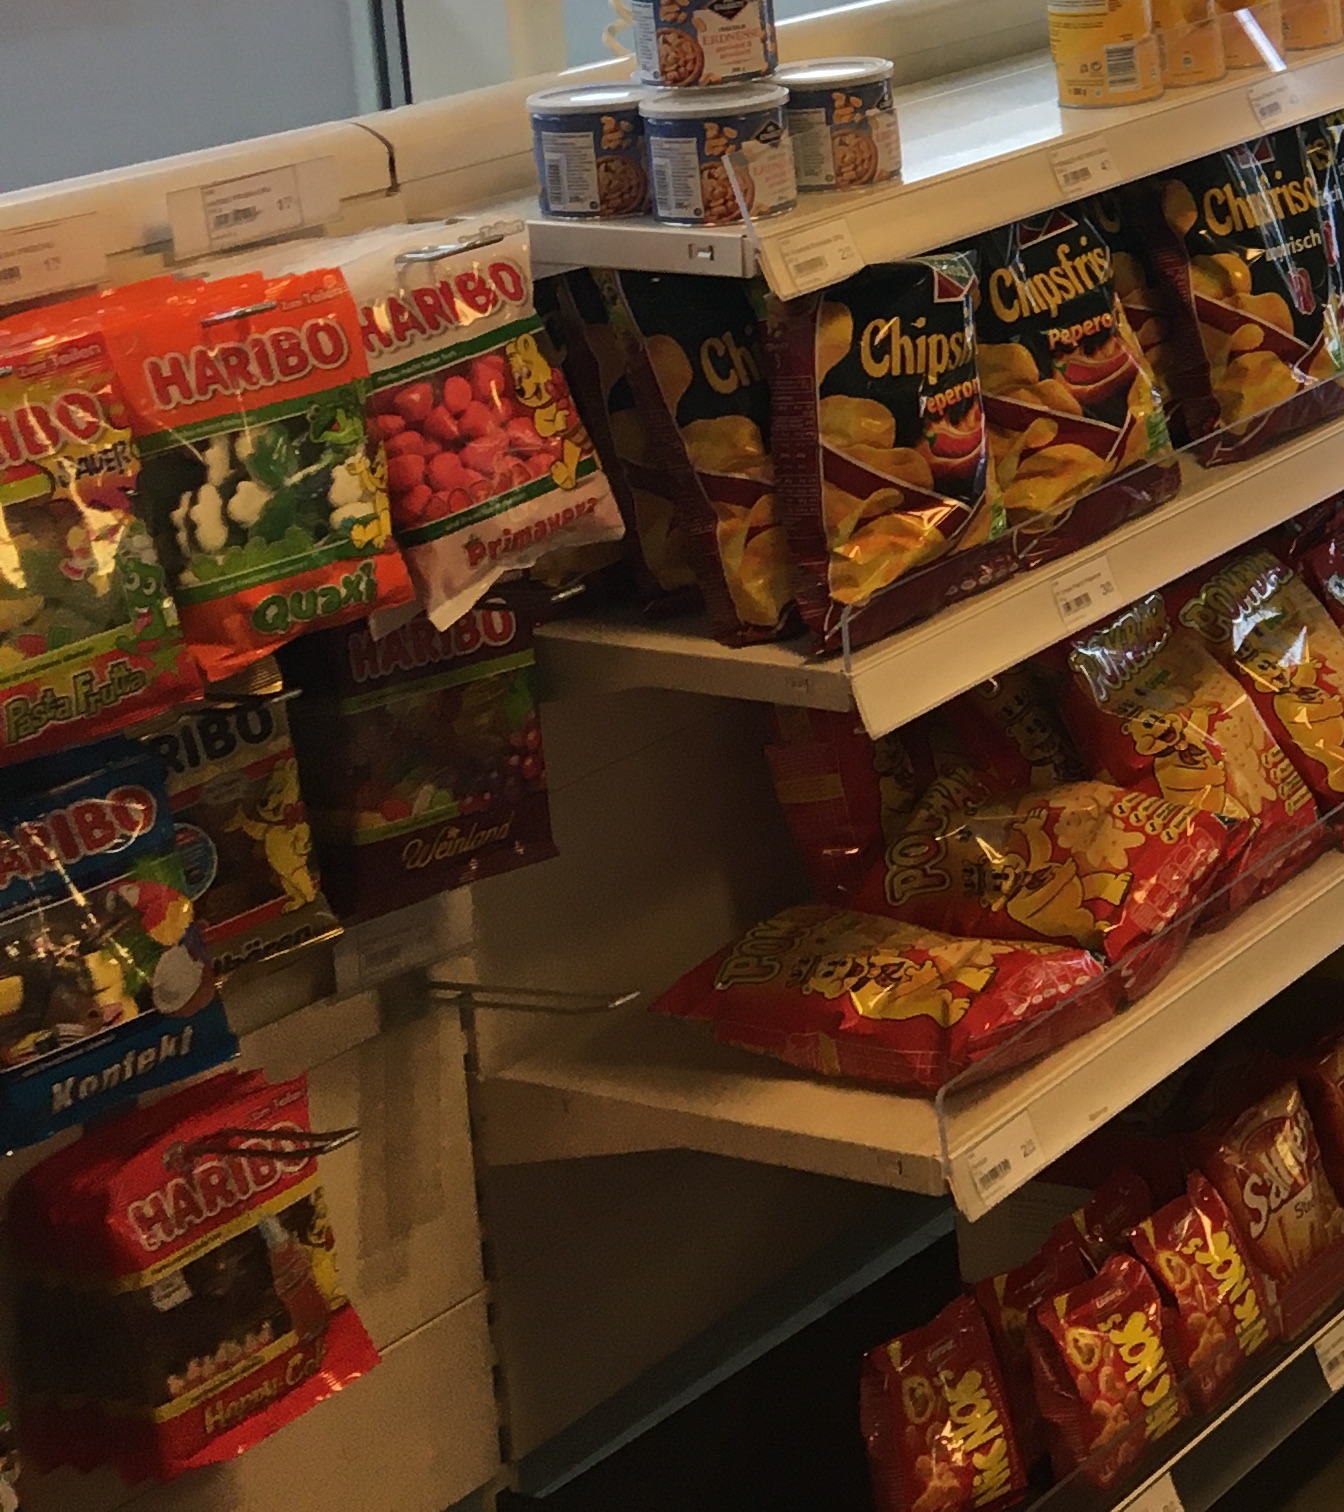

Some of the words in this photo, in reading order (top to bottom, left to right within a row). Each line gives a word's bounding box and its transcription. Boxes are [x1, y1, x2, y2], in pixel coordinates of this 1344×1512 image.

[358, 261, 527, 358] HARIBO
[989, 237, 1111, 322] Chipsfris
[143, 317, 349, 411] HARIBO
[1047, 312, 1113, 347] Pepero
[0, 388, 104, 475] IBO
[465, 497, 600, 567] Primavera
[252, 560, 377, 635] Quaxi
[150, 704, 273, 775] RIBO
[0, 785, 158, 884] ARIBO
[402, 810, 516, 871] Weinland
[50, 1025, 195, 1115] Konfekt
[127, 1120, 312, 1254] HARIBO
